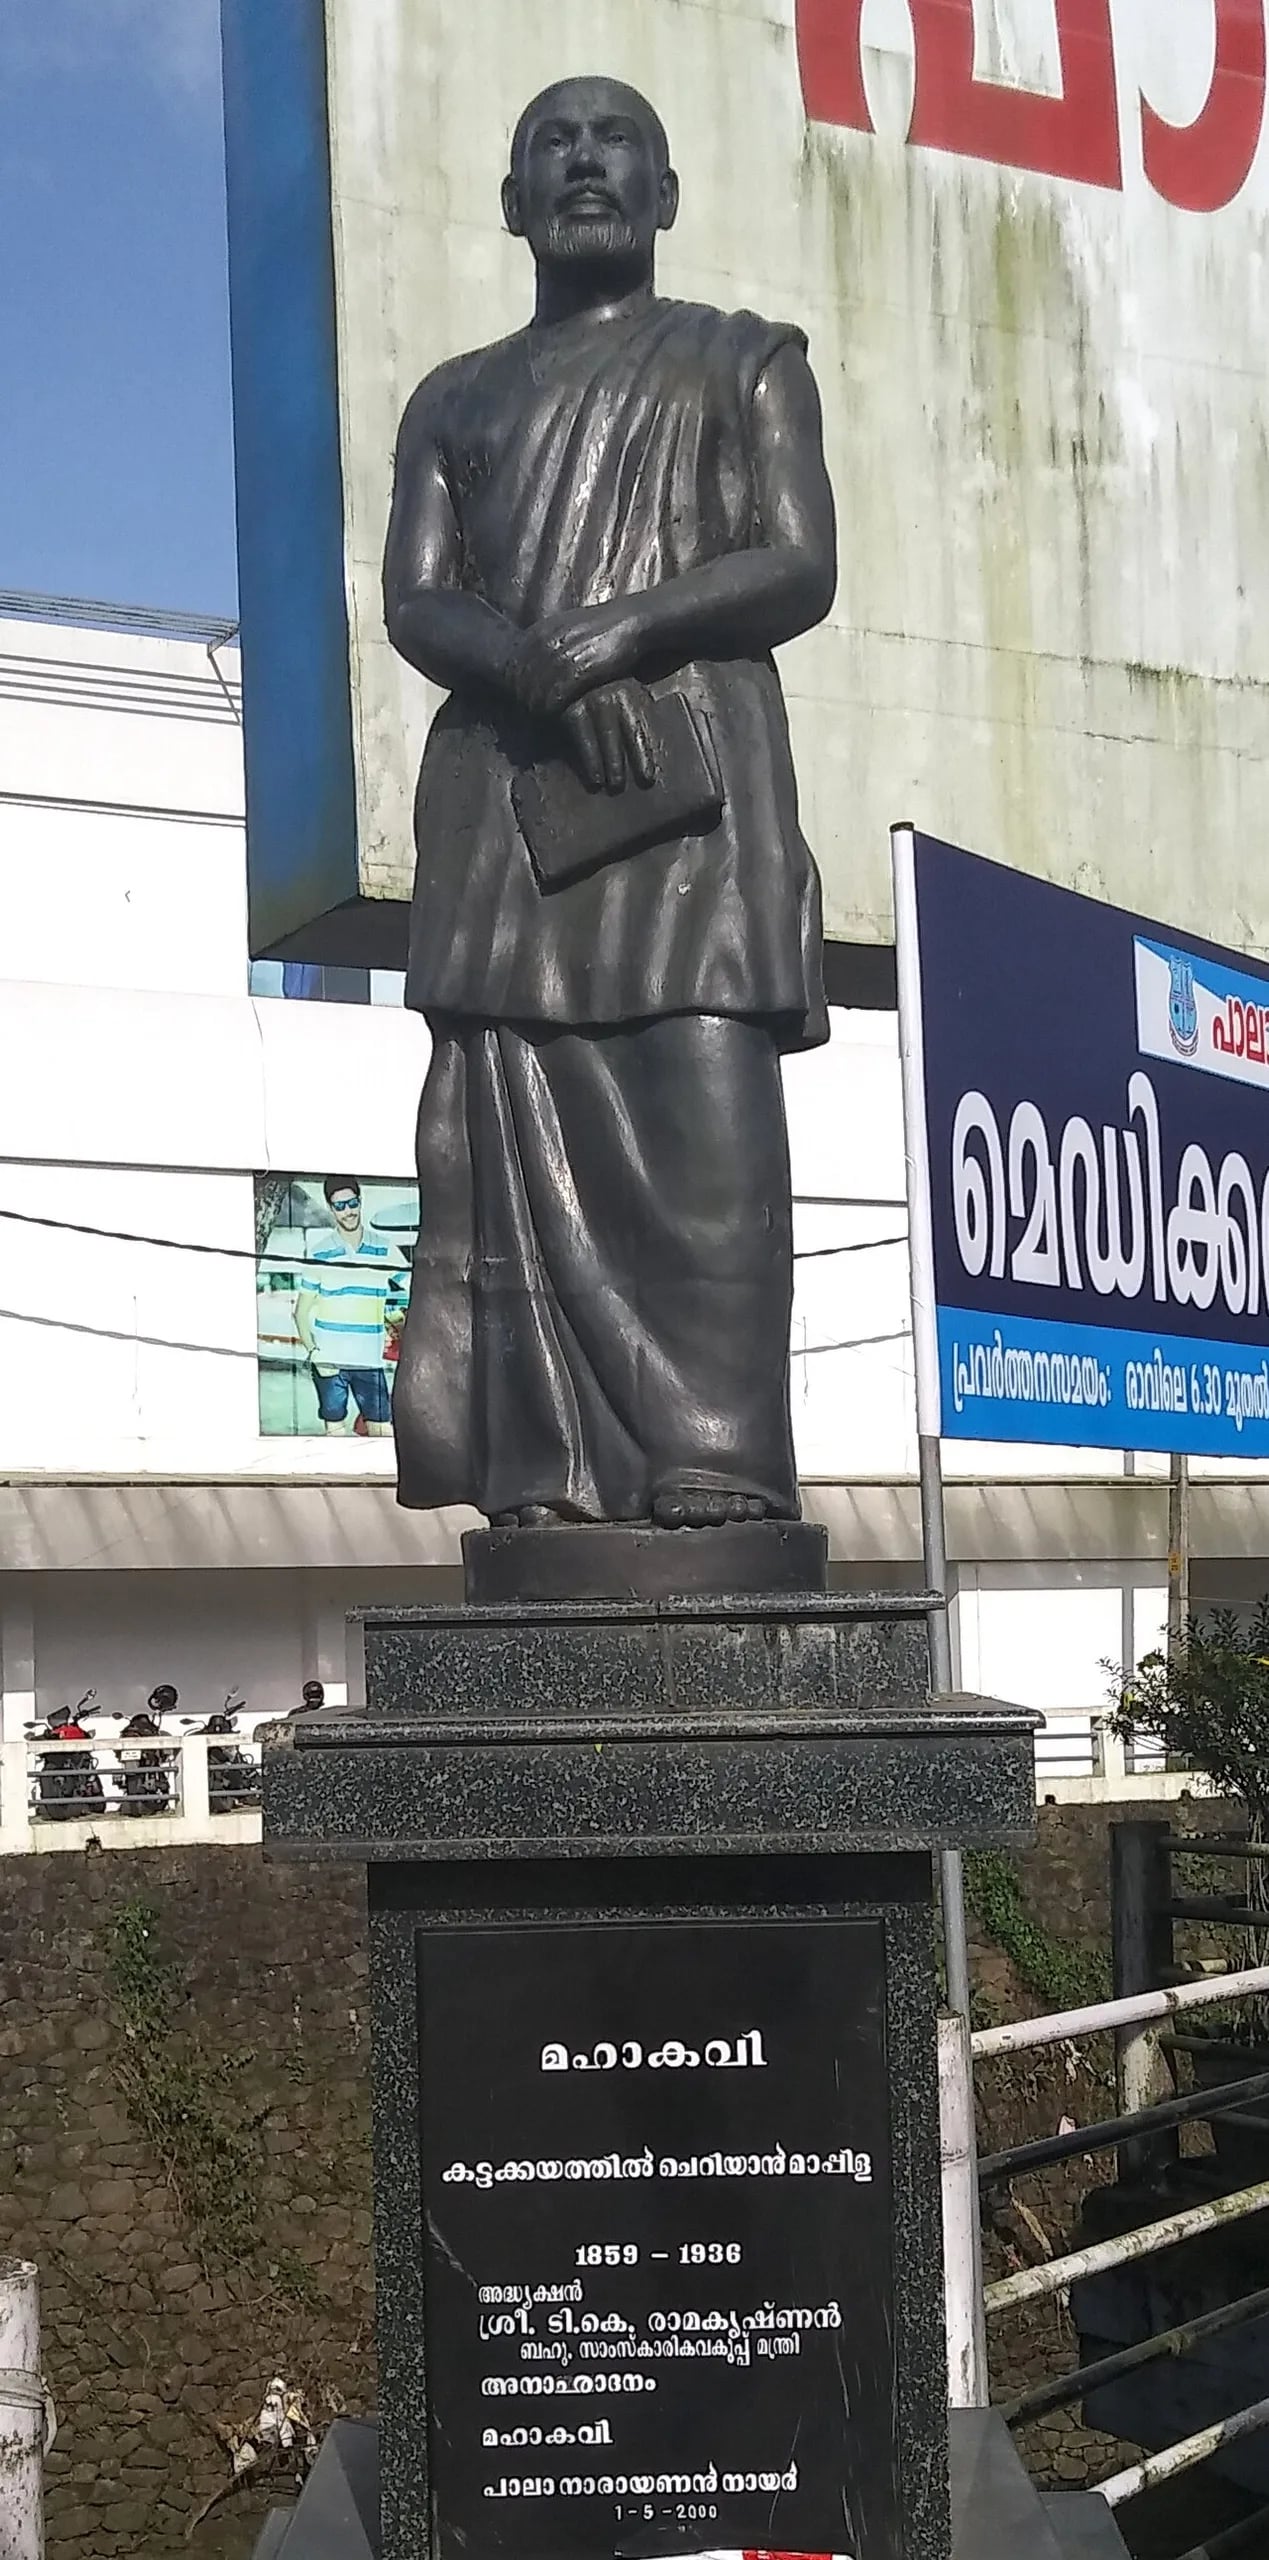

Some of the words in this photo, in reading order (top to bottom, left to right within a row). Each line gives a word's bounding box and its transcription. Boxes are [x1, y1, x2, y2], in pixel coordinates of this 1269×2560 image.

[951, 1070, 1269, 1316] മെഡിക്ക
[1124, 1345, 1188, 1414] രാവിലെ
[1190, 1363, 1222, 1415] 6.30
[540, 2028, 769, 2072] മഹാകവി
[441, 2145, 655, 2189] കട്ടക്കയത്തിൽ
[658, 2142, 788, 2178] ചെറിയാൻ
[788, 2147, 873, 2183] മാപ്പിള
[574, 2244, 639, 2267] 1859
[679, 2243, 742, 2265] 1936
[479, 2308, 536, 2341] ശ്രീ.
[547, 2306, 636, 2336] ടി.കെ.
[647, 2300, 843, 2340] രാമകൃഷ്ണൻ
[519, 2340, 574, 2367] ബഹു.
[481, 2418, 615, 2447] മഹാകവി
[482, 2476, 555, 2498] പാലാ
[558, 2460, 719, 2496] നാരായണൻ
[721, 2460, 799, 2493] നായർ
